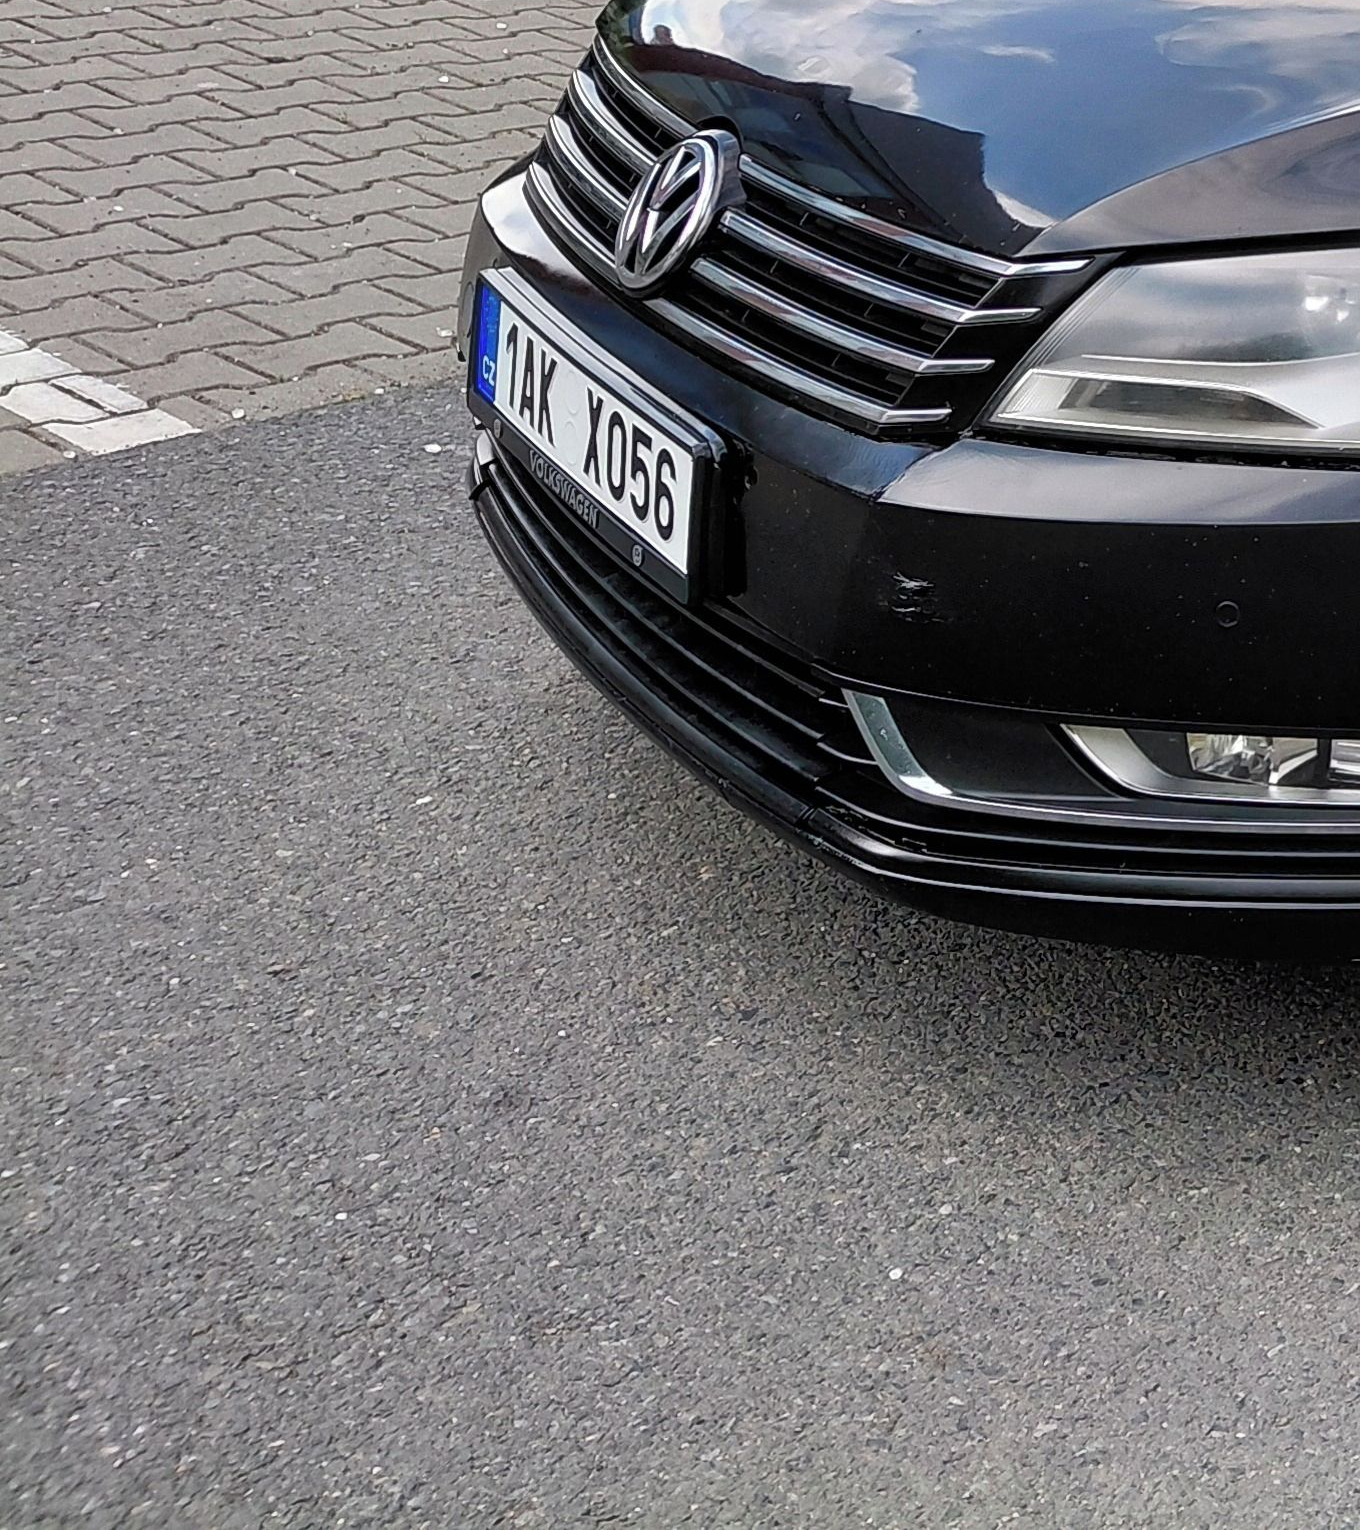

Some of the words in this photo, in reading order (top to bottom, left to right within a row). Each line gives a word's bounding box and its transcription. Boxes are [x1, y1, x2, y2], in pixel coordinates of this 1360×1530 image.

[482, 355, 496, 387] CZ
[506, 322, 558, 448] 1AK
[583, 386, 677, 541] X056
[529, 449, 599, 529] VOLKSWAGEN
